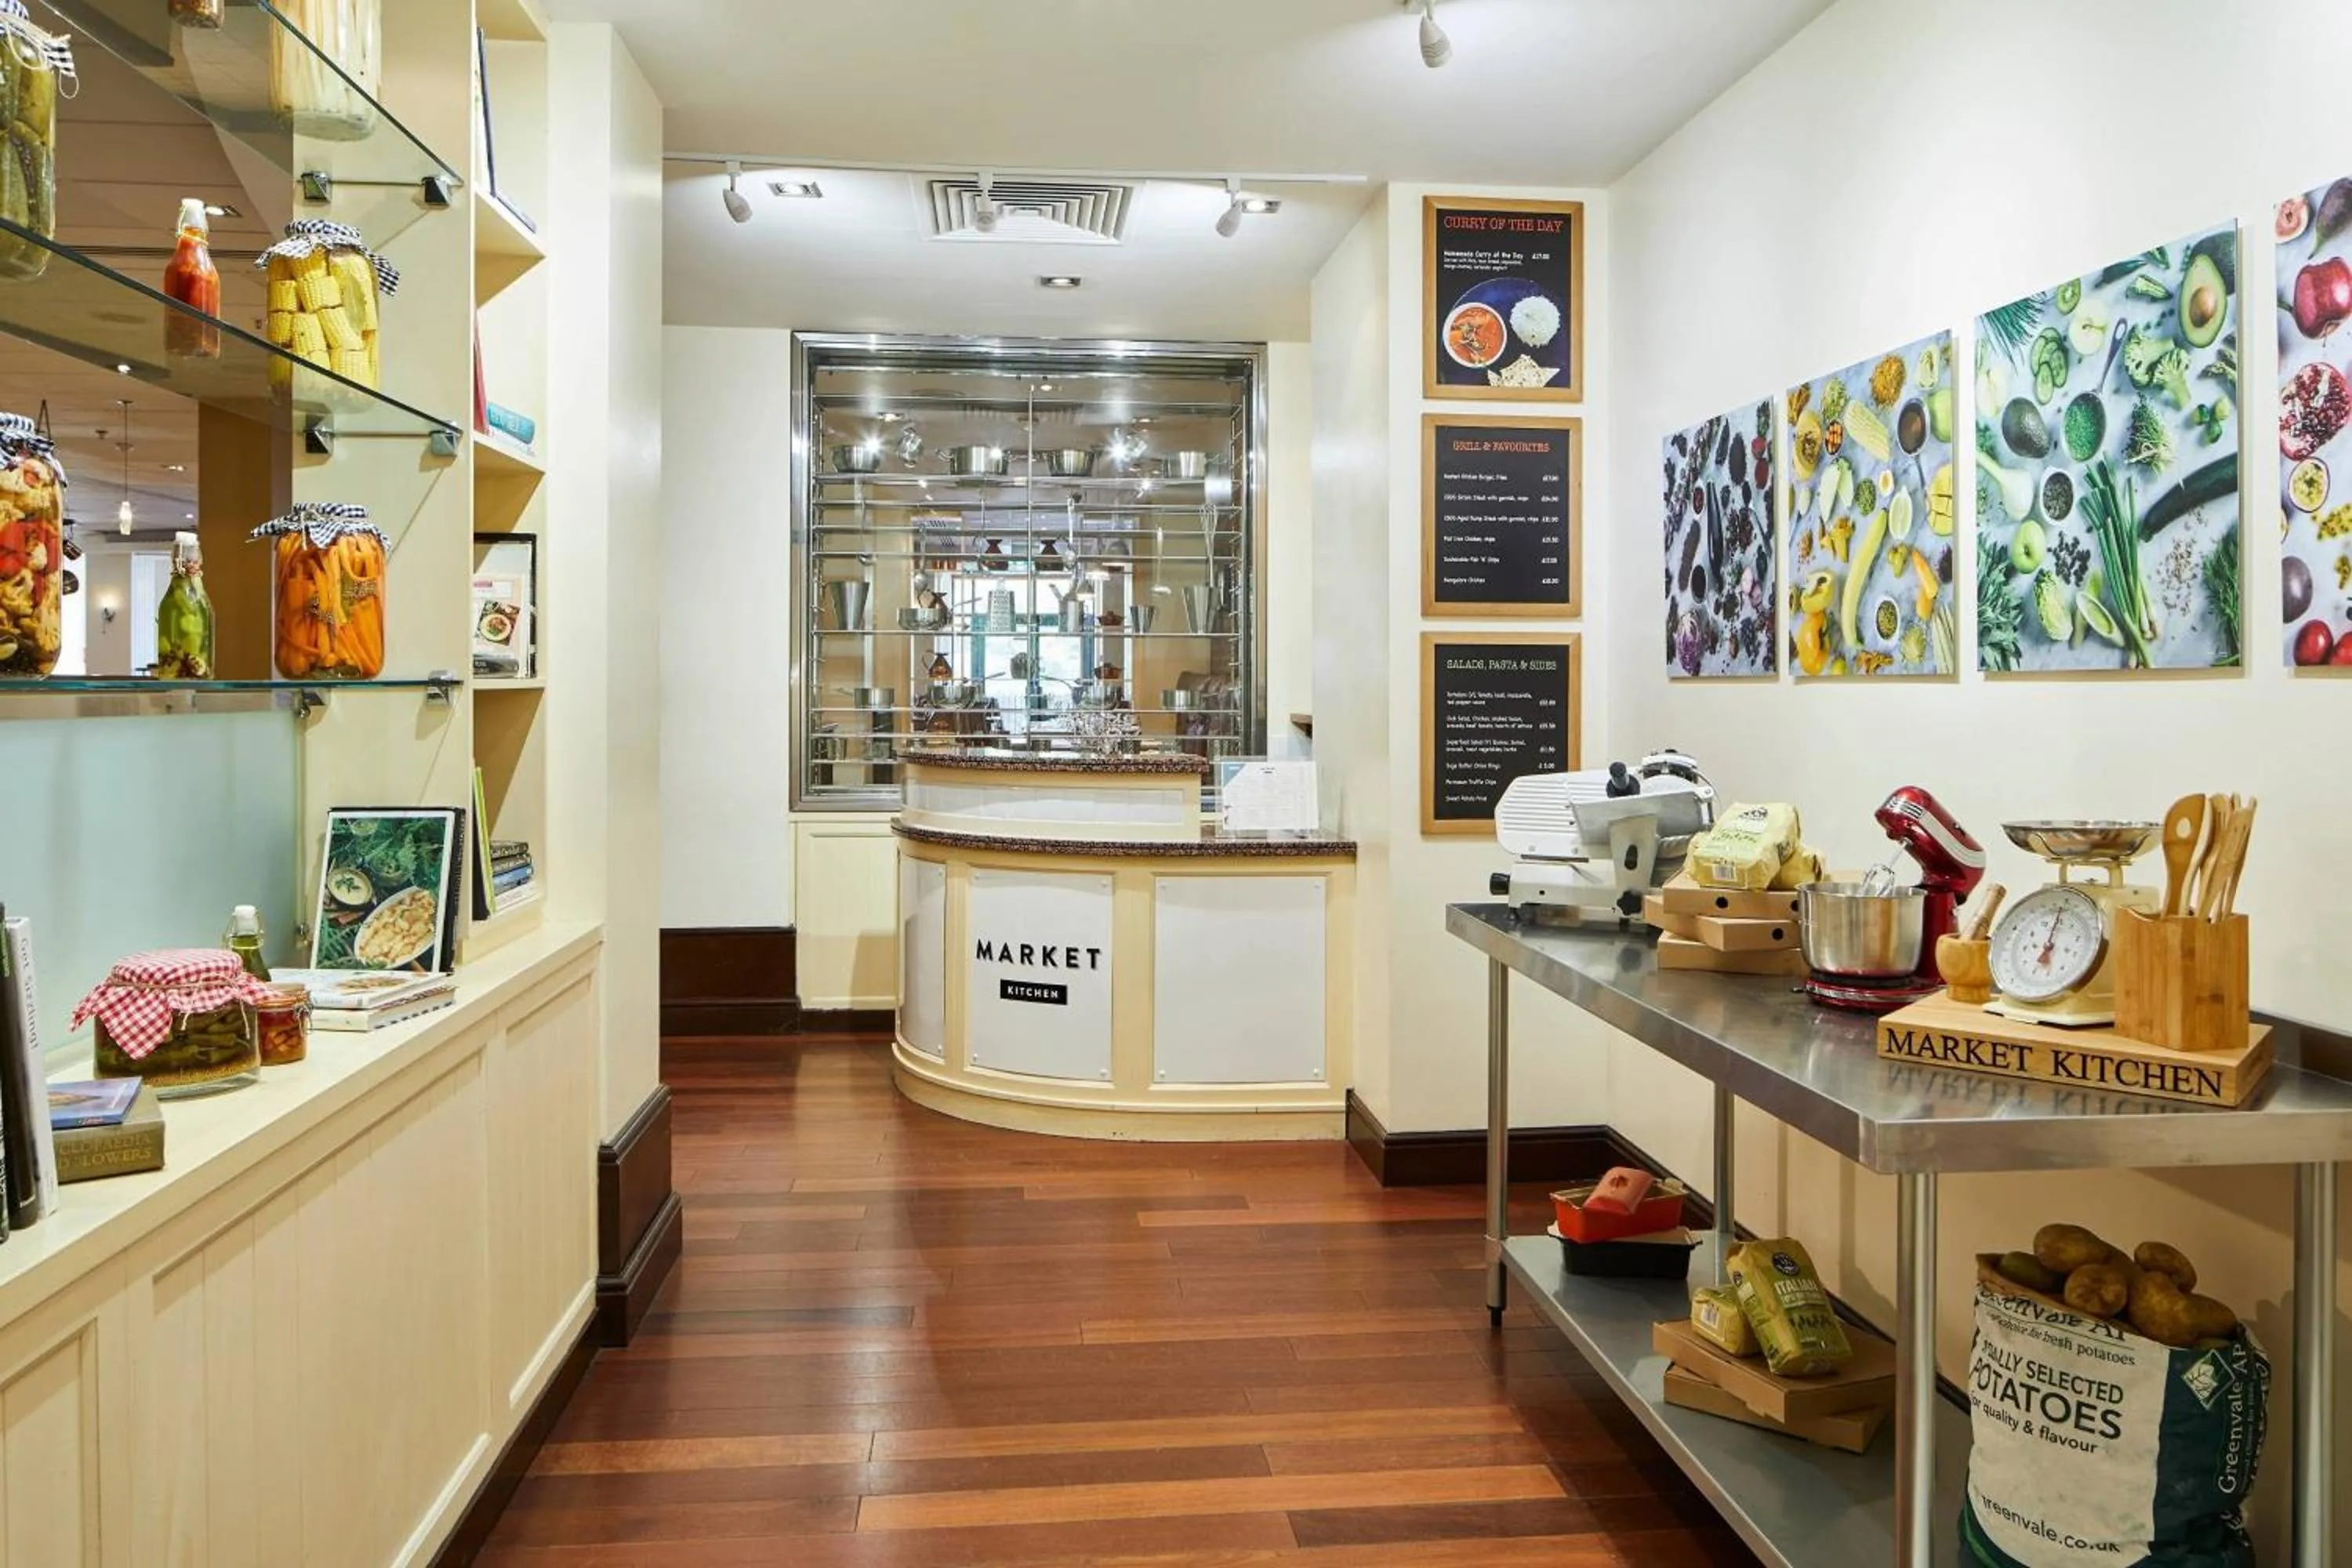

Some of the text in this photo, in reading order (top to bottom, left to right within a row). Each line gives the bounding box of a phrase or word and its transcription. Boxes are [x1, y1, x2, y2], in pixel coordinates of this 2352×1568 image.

[1443, 216, 1563, 233] CURRY OF THE DAY
[1453, 441, 1550, 452] GRILL & FAVOURITES
[1446, 659, 1486, 670] SALADS,
[1490, 660, 1518, 670] PASTA
[1530, 661, 1556, 670] SIDES
[21, 938, 30, 968] Get
[976, 938, 1101, 969] MARKET
[1007, 985, 1058, 999] KITCHEN
[1886, 1029, 2223, 1098] MARKET KITCHEN
[74, 1149, 151, 1167] LOWERS
[1774, 1279, 1819, 1295] ITALIAN
[2076, 1343, 2136, 1365] potatoes
[2026, 1360, 2123, 1404] SELECTED
[1969, 1357, 2122, 1439] POTATOES
[1983, 1403, 2020, 1432] quality
[2023, 1420, 2034, 1436] &
[2039, 1425, 2099, 1454] flavour
[2218, 1381, 2244, 1494] Greenvale
[2233, 1343, 2248, 1374] AP
[1981, 1494, 2121, 1552] reenvale.co.uk
